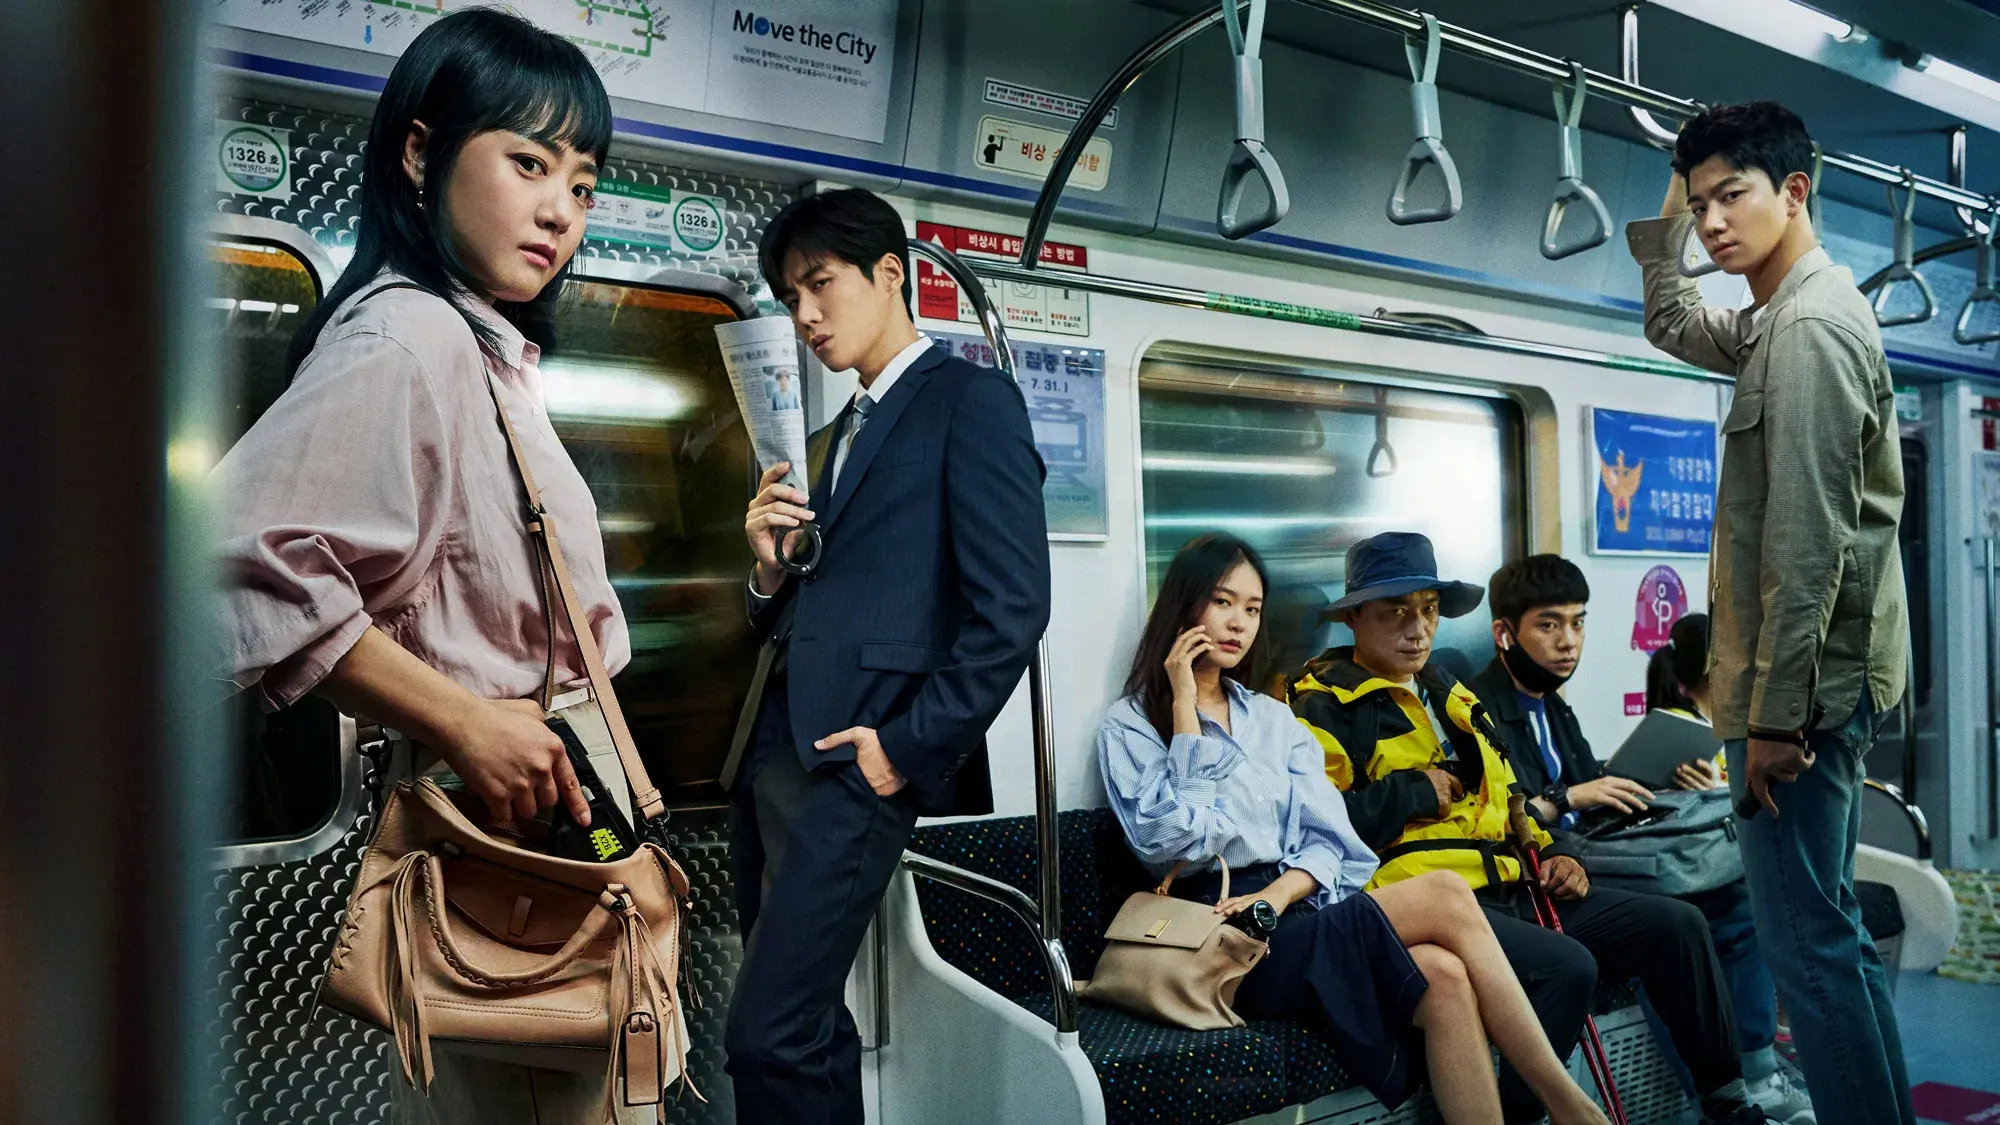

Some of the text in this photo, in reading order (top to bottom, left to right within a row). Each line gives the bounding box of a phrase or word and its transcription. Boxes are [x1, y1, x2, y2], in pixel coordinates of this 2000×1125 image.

[732, 10, 877, 64] Move the City
[228, 147, 279, 165] 1326 호
[1021, 142, 1046, 161] 비상
[680, 213, 708, 228] 1326
[968, 234, 997, 250] 비상시
[1002, 238, 1023, 253] 출입
[1056, 247, 1074, 262] 방법
[961, 342, 1018, 367] 성범
[1025, 350, 1058, 374] 집중
